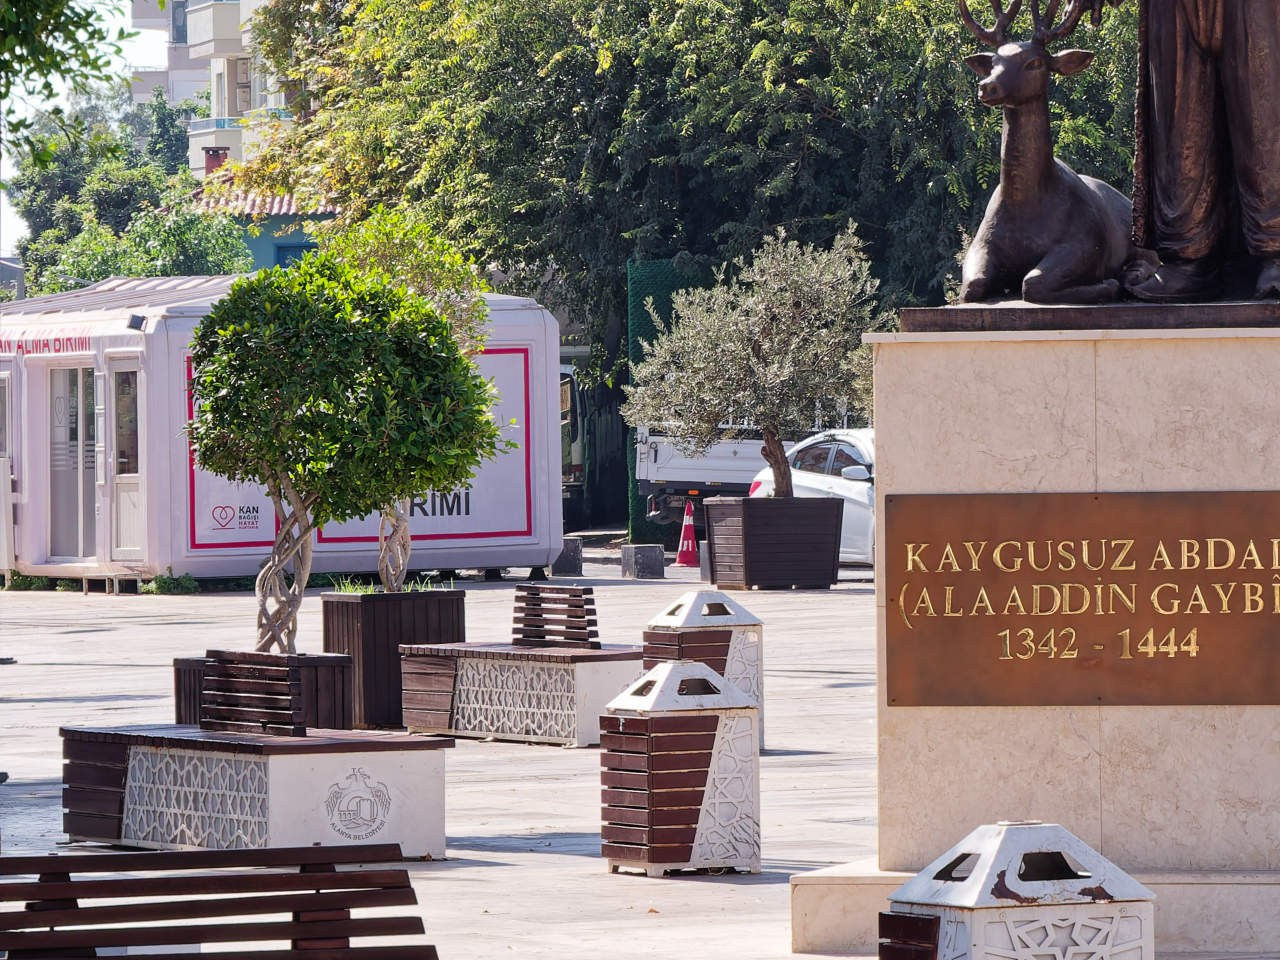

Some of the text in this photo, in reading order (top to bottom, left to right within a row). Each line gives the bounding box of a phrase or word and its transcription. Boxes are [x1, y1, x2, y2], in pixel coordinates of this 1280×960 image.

[238, 505, 259, 514] KAN
[381, 487, 470, 517] RİMİ
[903, 539, 1137, 573] KAYGUSUZ
[899, 576, 1137, 629] (ALAADDİN
[997, 627, 1079, 660] 1342
[1117, 627, 1200, 659] 1444
